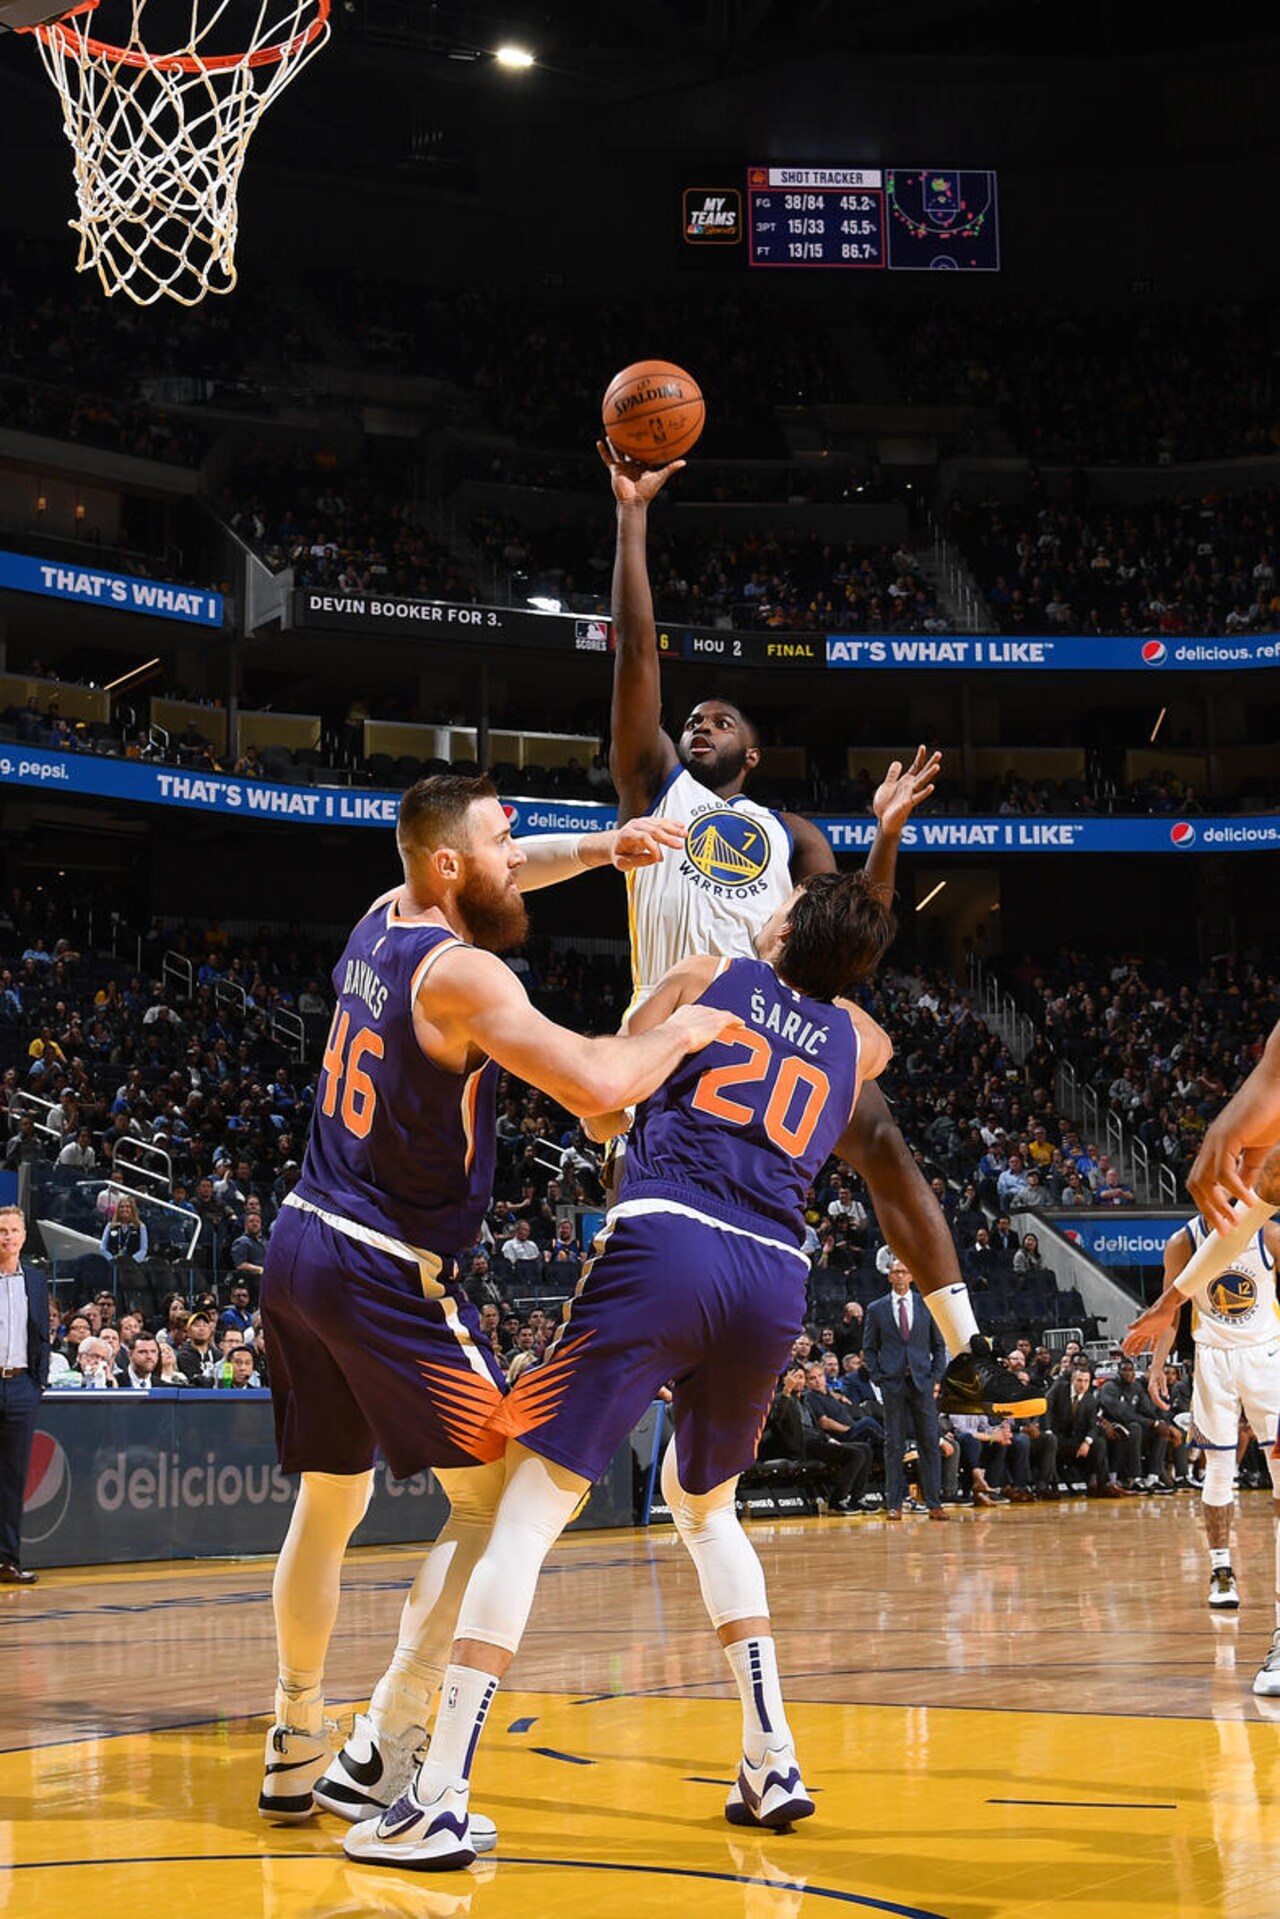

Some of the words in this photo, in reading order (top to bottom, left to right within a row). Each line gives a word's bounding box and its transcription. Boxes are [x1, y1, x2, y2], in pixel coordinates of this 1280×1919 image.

[780, 171, 811, 183] SHOT
[813, 172, 863, 185] TRACKER
[703, 197, 726, 211] MY
[755, 198, 771, 208] FG
[784, 194, 824, 211] 38/84
[691, 211, 736, 225] TEAMS
[756, 222, 776, 232] 3PT
[787, 218, 825, 235] 15/33
[757, 246, 770, 256] FT
[788, 242, 823, 259] 13/15
[614, 386, 684, 417] SPALDING
[40, 565, 128, 602] THAT'S
[132, 583, 204, 616] WHAT
[208, 598, 217, 619] I
[309, 596, 366, 615] DEVIN
[370, 602, 443, 622] BOOKER
[447, 609, 482, 625] FOR
[486, 612, 502, 627] 3.
[575, 639, 607, 652] SCORES
[660, 633, 670, 650] 6
[693, 638, 725, 653] HOU
[732, 640, 742, 657] 2
[767, 643, 815, 657] FINAL
[891, 641, 969, 662] WHAT
[975, 642, 982, 662] I
[1175, 645, 1253, 661] delicious.
[18, 761, 69, 780] pepsi.
[157, 774, 241, 807] THAT'S
[246, 787, 320, 816] WHAT
[325, 796, 334, 817] I
[527, 812, 602, 831] delicious.
[741, 831, 758, 852] 7
[922, 825, 999, 845] WHAT
[1004, 825, 1013, 845] I
[678, 860, 769, 900] WARRIORS
[342, 959, 389, 1020] BAYNES
[750, 987, 831, 1056] ŠARIĆ
[321, 1000, 385, 1139] 46
[690, 1022, 831, 1159] 20
[1238, 1281, 1251, 1295] 12
